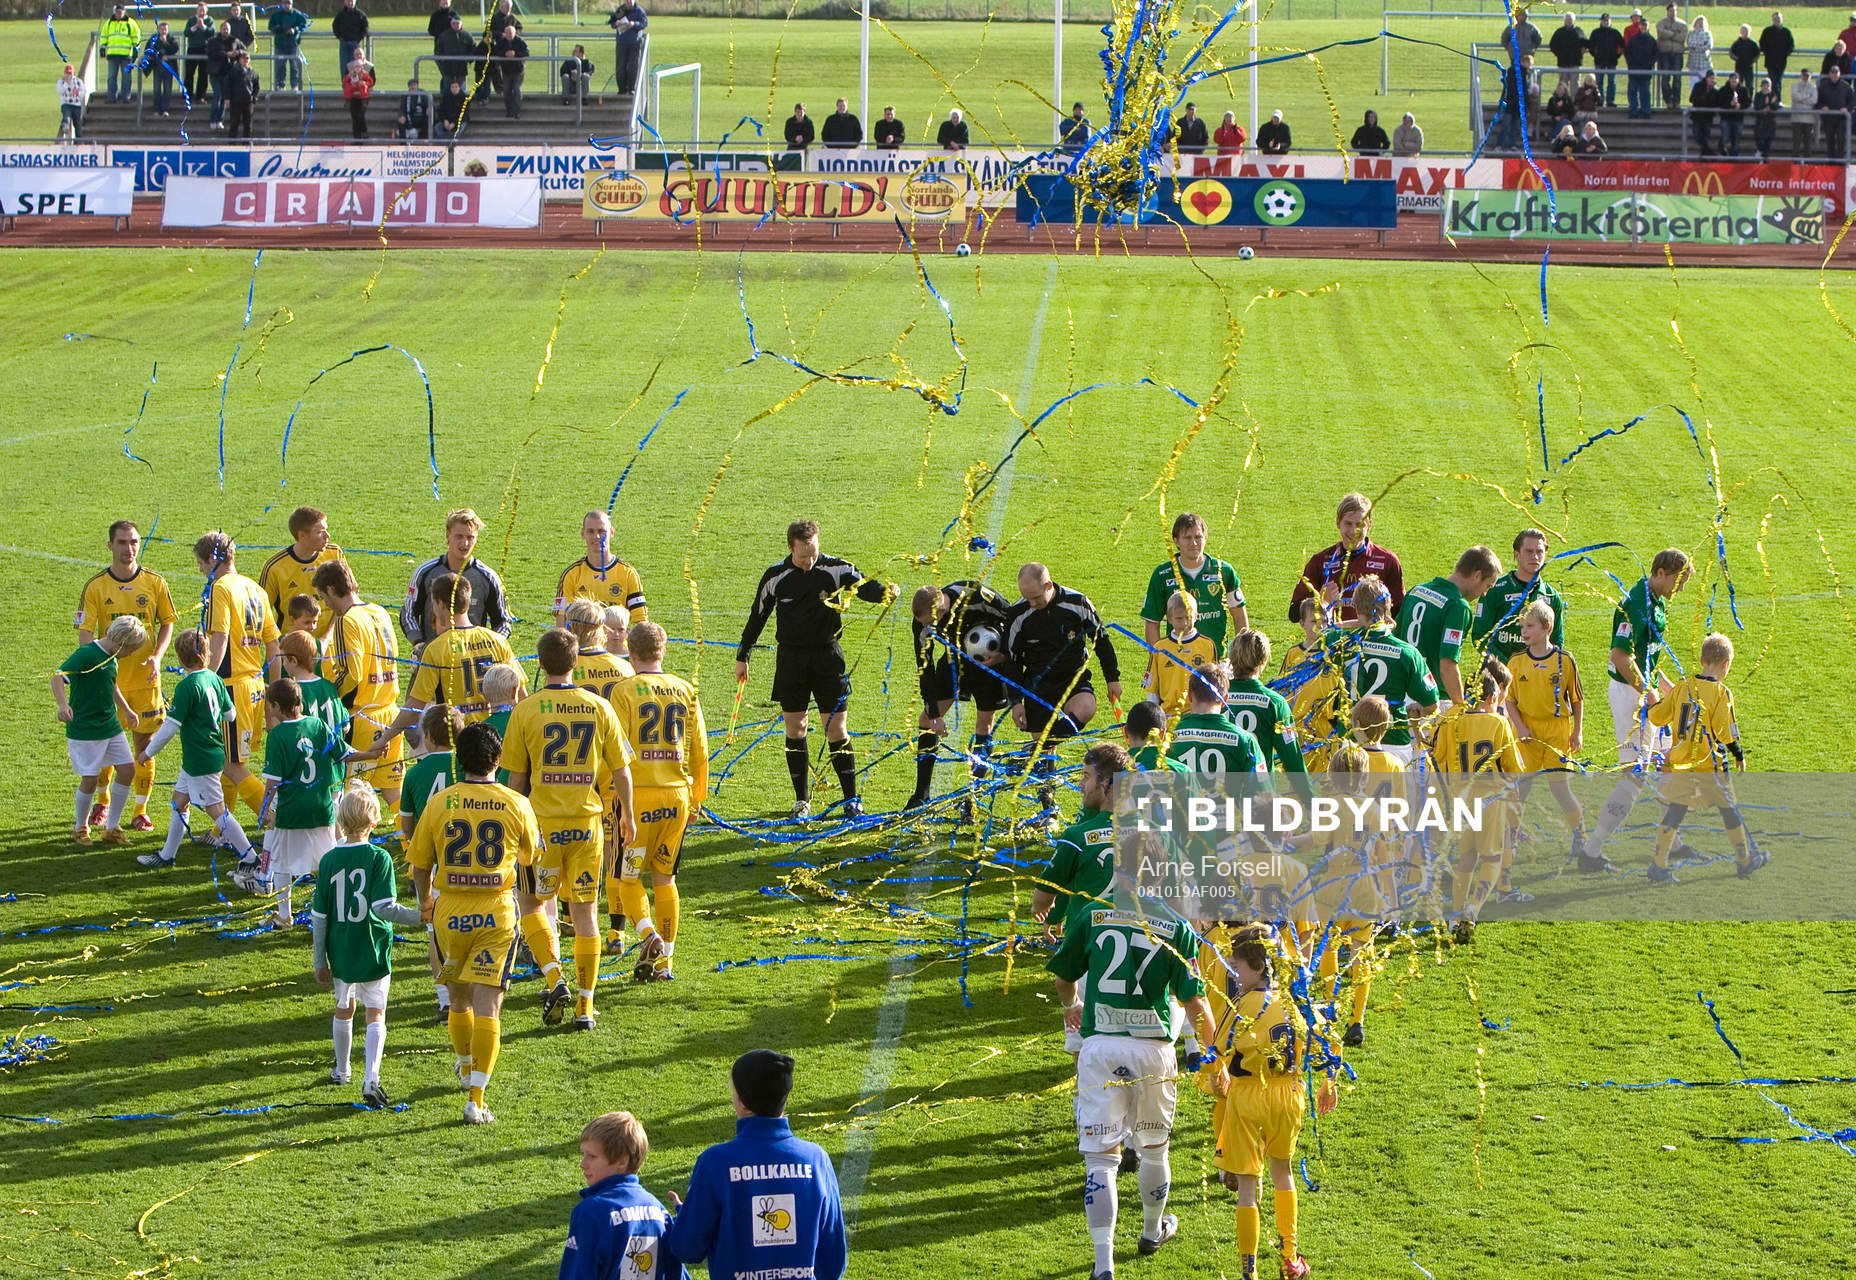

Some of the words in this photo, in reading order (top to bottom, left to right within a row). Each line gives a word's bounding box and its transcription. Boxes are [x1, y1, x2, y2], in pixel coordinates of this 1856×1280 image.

[0, 153, 98, 168] LSMASKINER
[509, 155, 602, 174] MUNKA
[1354, 158, 1465, 196] MAXI
[1584, 174, 1616, 186] Norra
[1623, 175, 1670, 187] infarten
[1749, 177, 1784, 189] Norra
[1788, 178, 1836, 191] infarten
[17, 193, 94, 215] SPEL
[234, 191, 468, 216] CRAMO
[594, 191, 642, 204] GULD
[659, 176, 888, 218] GUUULD!
[1451, 196, 1759, 240] Kraftaktörerna
[1407, 602, 1426, 647] 8
[464, 640, 495, 651] Mentor
[1363, 642, 1400, 654] MGRENS
[556, 703, 596, 715] Mentor
[638, 701, 688, 745] 26
[543, 720, 597, 767] 27
[1177, 730, 1237, 740] HOLMGRENS
[297, 736, 316, 784] 3
[543, 773, 593, 784] CRAMO
[463, 798, 506, 811] Mentor
[445, 819, 505, 868] 28
[549, 827, 593, 846] agDA
[449, 873, 501, 885] CRAMO
[329, 867, 369, 923] 13
[448, 913, 497, 932] agDA
[1104, 911, 1175, 932] HOLMRENS
[1097, 928, 1165, 996] 27
[729, 1163, 812, 1182] BOLLKALLE
